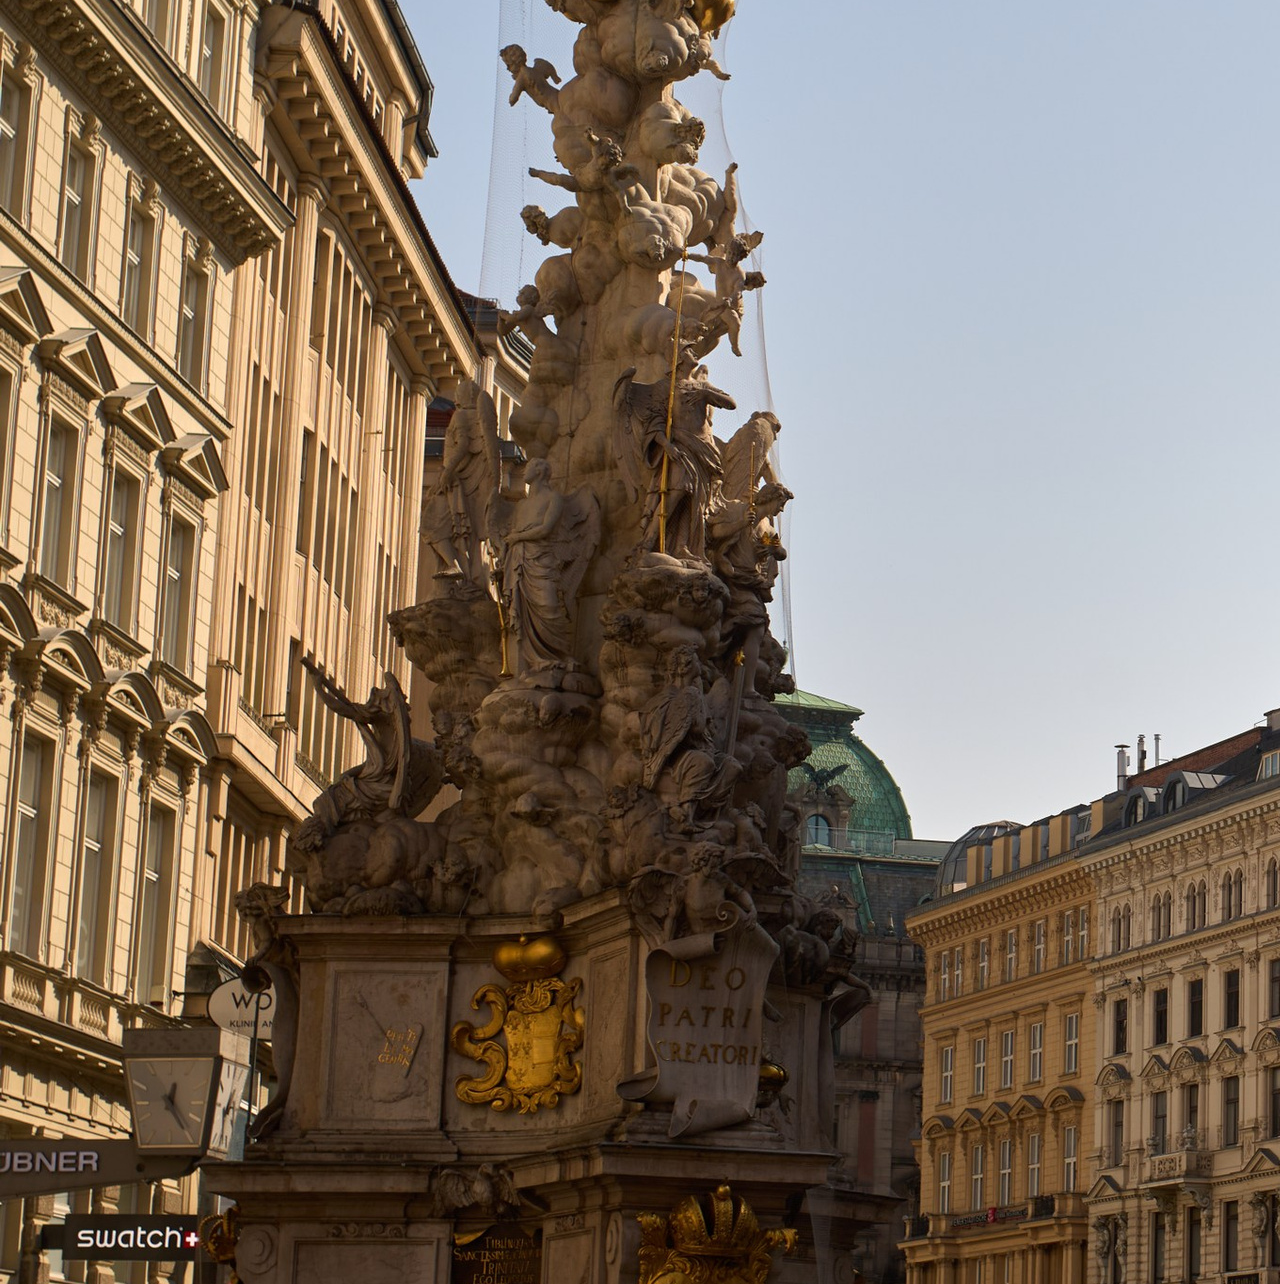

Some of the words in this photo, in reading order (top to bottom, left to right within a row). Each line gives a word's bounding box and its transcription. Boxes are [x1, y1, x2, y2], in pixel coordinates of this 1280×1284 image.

[669, 959, 746, 990] DEO
[658, 1002, 752, 1028] PATRI
[656, 1041, 758, 1066] CREATORI
[0, 1151, 99, 1173] ÜBNER
[77, 1226, 182, 1248] swatch
